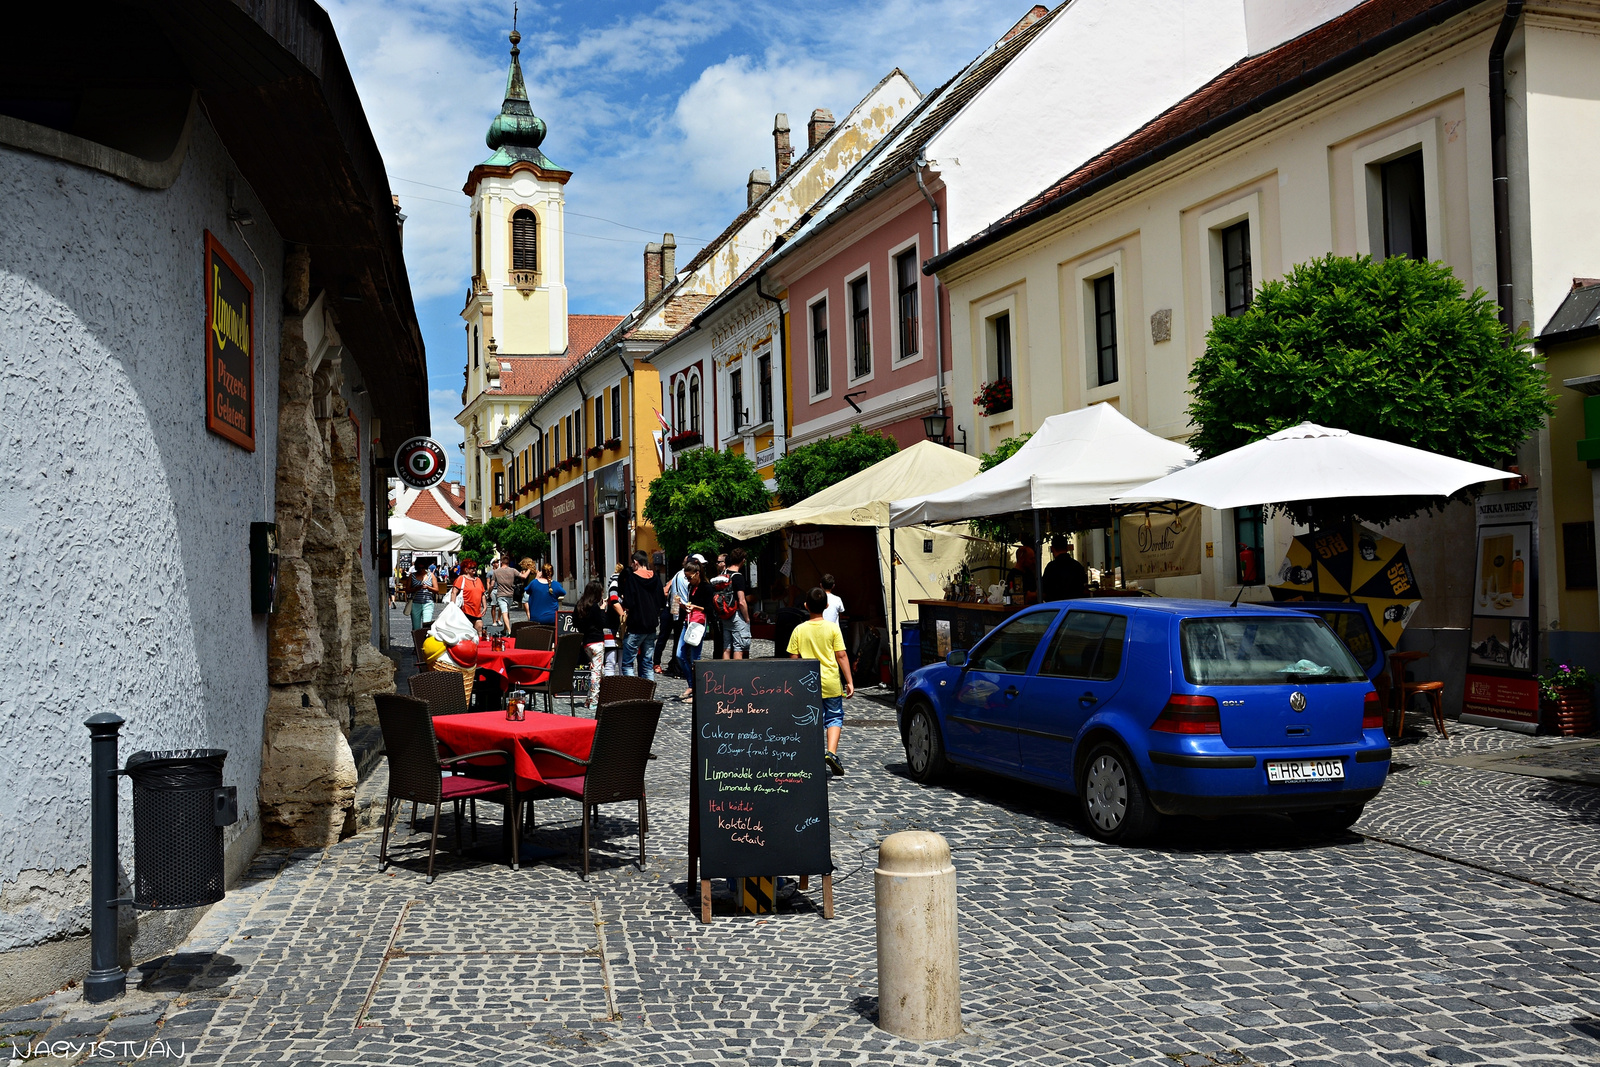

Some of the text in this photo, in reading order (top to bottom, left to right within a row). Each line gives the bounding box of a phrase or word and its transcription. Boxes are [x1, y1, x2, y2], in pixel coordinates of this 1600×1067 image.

[217, 358, 247, 401] Pizzeria
[217, 393, 247, 432] Gelateria
[405, 441, 440, 453] NEMZETI
[417, 458, 427, 468] T
[1480, 501, 1533, 514] NIKKA WHISKY
[1318, 540, 1349, 559] BIG
[1387, 566, 1405, 595] BIG
[1395, 562, 1411, 591] PEAT
[703, 670, 744, 704] Belga
[715, 701, 769, 719] Belgian Beers
[701, 722, 735, 739] Cukor
[746, 743, 768, 757] fruit
[772, 749, 797, 760] syrup
[756, 768, 785, 779] cukor
[709, 800, 725, 812] Ital
